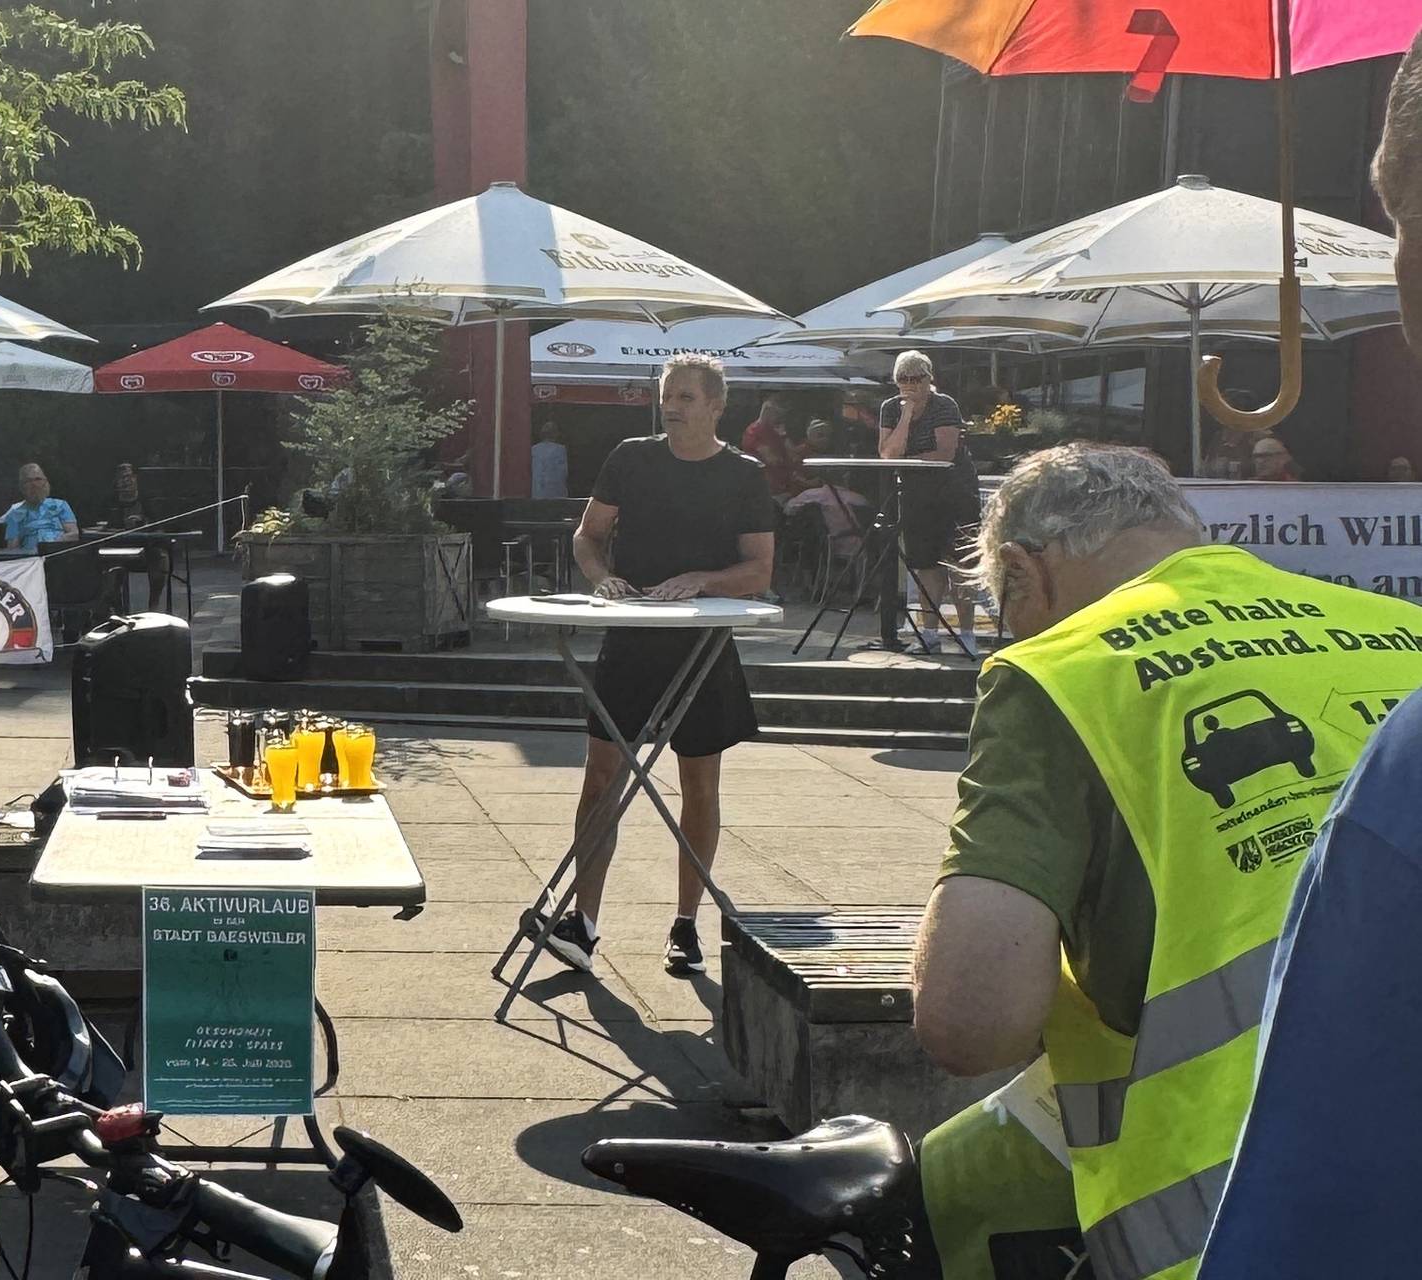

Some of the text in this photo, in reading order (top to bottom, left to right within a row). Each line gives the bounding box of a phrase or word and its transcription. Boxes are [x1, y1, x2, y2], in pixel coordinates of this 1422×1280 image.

[1201, 513, 1328, 546] rzlich
[1098, 597, 1326, 653] Bitte halte
[1133, 629, 1329, 692] Abstand.
[149, 896, 310, 914] 36. AKTIVURLAUB
[153, 929, 307, 945] STADT BAESWEILER
